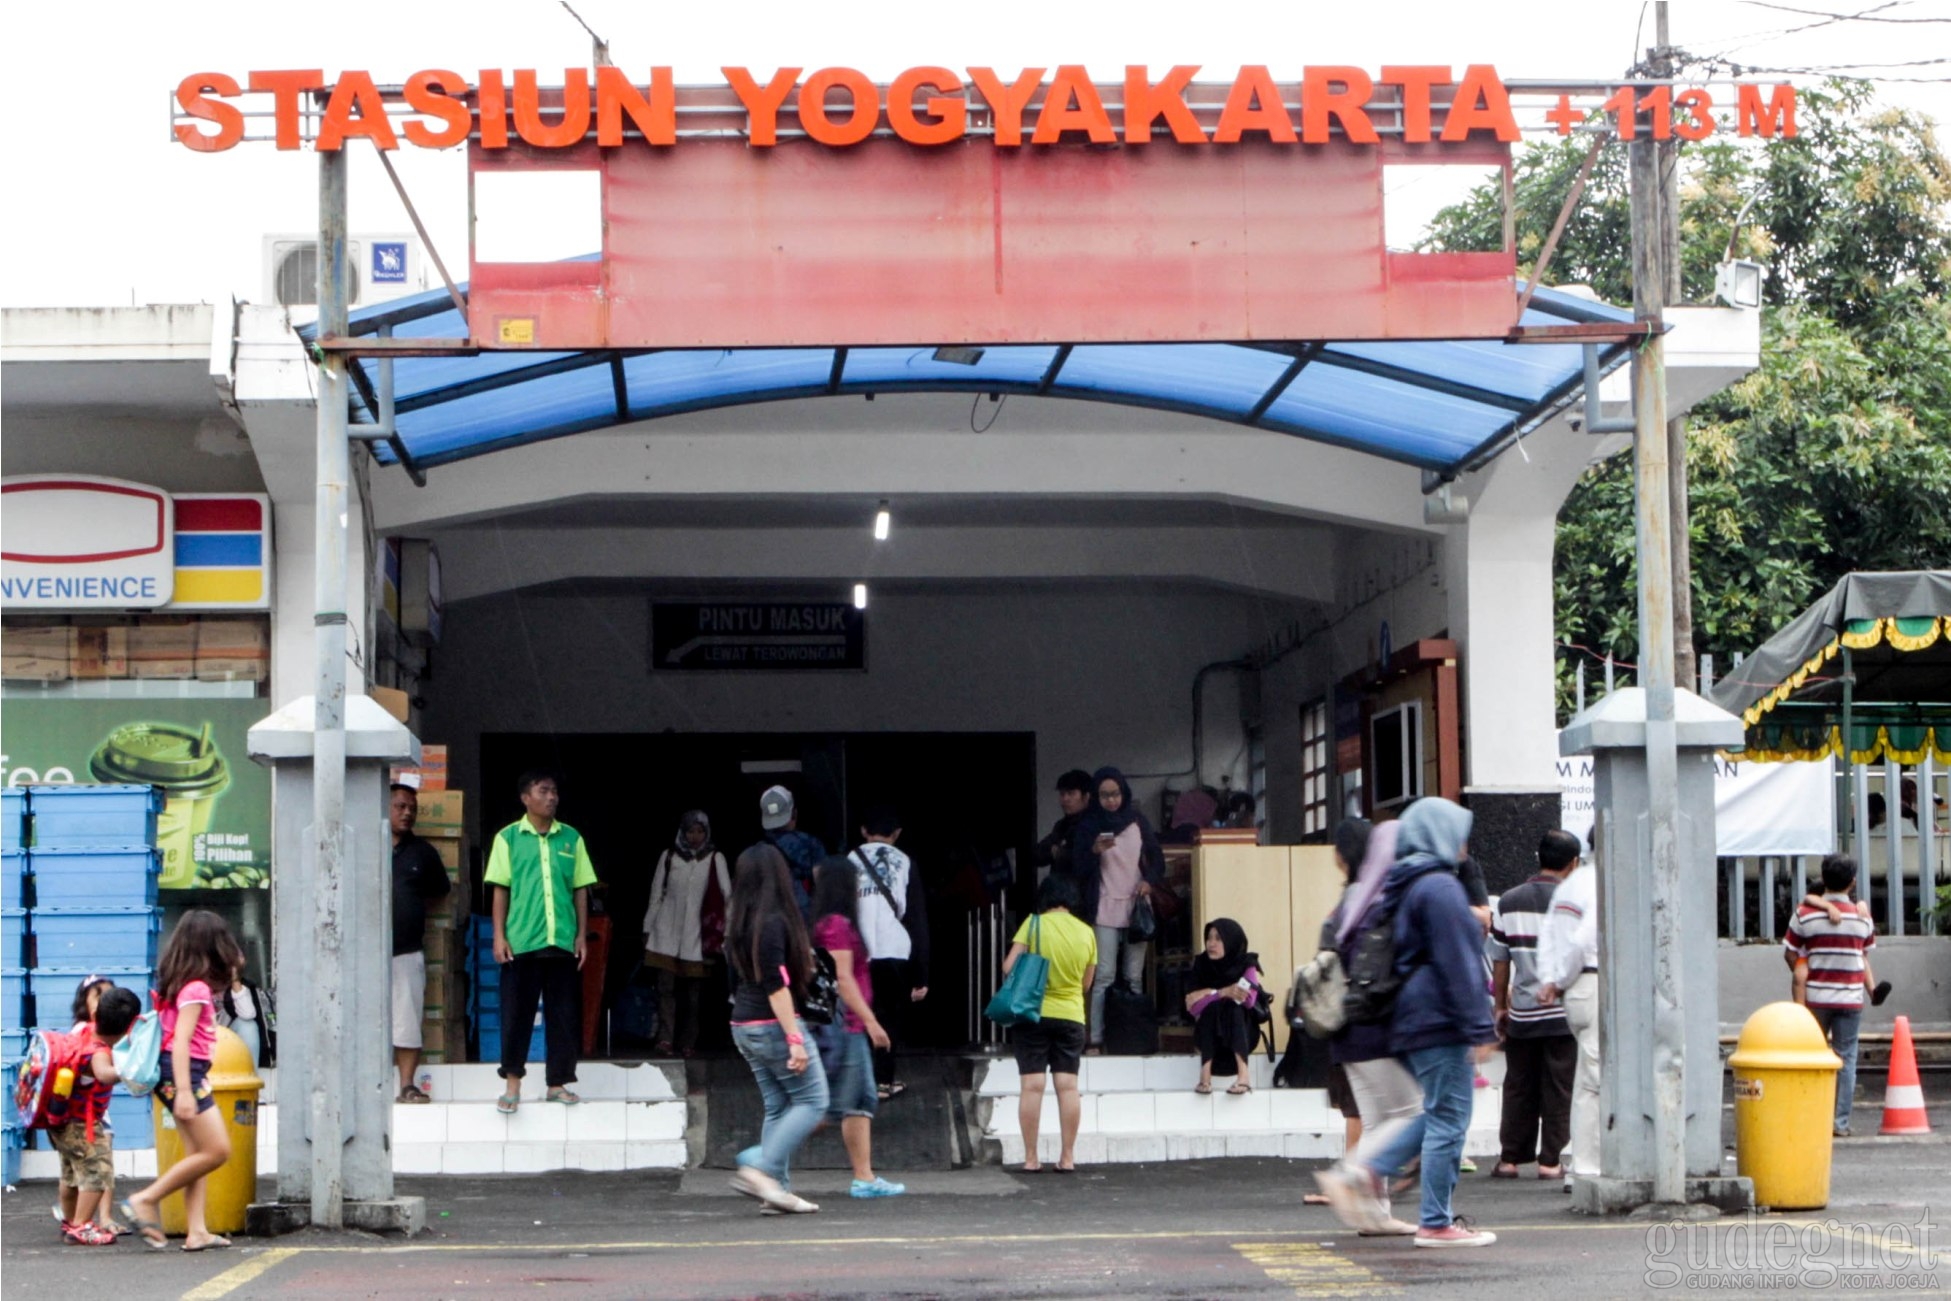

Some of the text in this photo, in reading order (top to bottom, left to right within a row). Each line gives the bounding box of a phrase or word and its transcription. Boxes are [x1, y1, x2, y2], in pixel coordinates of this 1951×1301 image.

[174, 66, 677, 153] STASIUN
[720, 64, 1522, 148] YOGYAKARTA
[1737, 84, 1797, 139] M
[699, 607, 846, 631] PINTU MASUK
[704, 646, 846, 661] LEWAT TEROWONGAN
[206, 847, 253, 862] Pilihan
